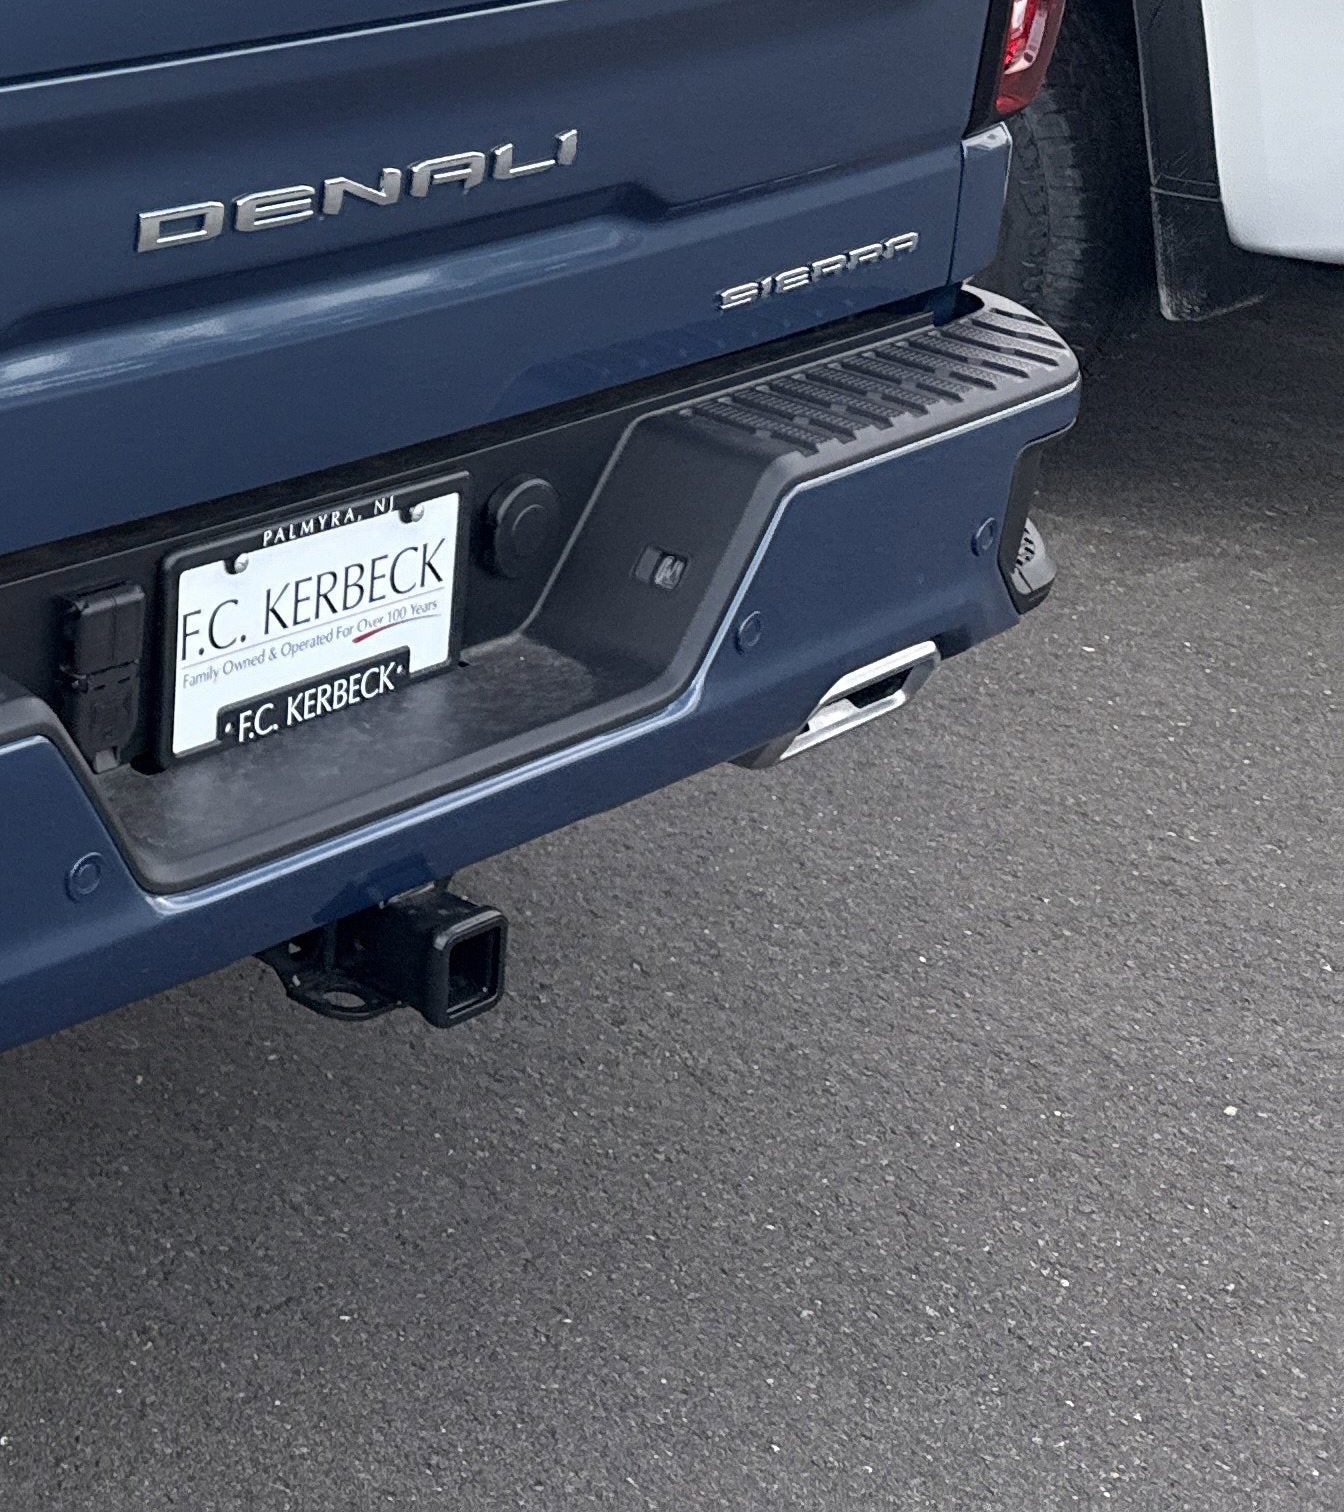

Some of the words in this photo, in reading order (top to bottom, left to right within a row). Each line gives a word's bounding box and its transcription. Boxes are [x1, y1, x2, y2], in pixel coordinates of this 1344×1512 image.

[136, 128, 579, 253] DENALI
[719, 231, 920, 310] SIERRA
[262, 506, 362, 547] PALMYRA,
[373, 495, 396, 515] NJ
[180, 598, 247, 662] F.C.
[263, 537, 447, 635] KERBECK
[182, 665, 220, 689] Family
[222, 649, 266, 675] Owned
[268, 648, 278, 661] &
[280, 628, 333, 657] Operated
[336, 624, 354, 640] For
[356, 616, 384, 633] Over
[387, 606, 407, 623] 100
[410, 600, 438, 615] Years
[238, 703, 279, 743] F.C.
[286, 662, 395, 726] KERBECK
